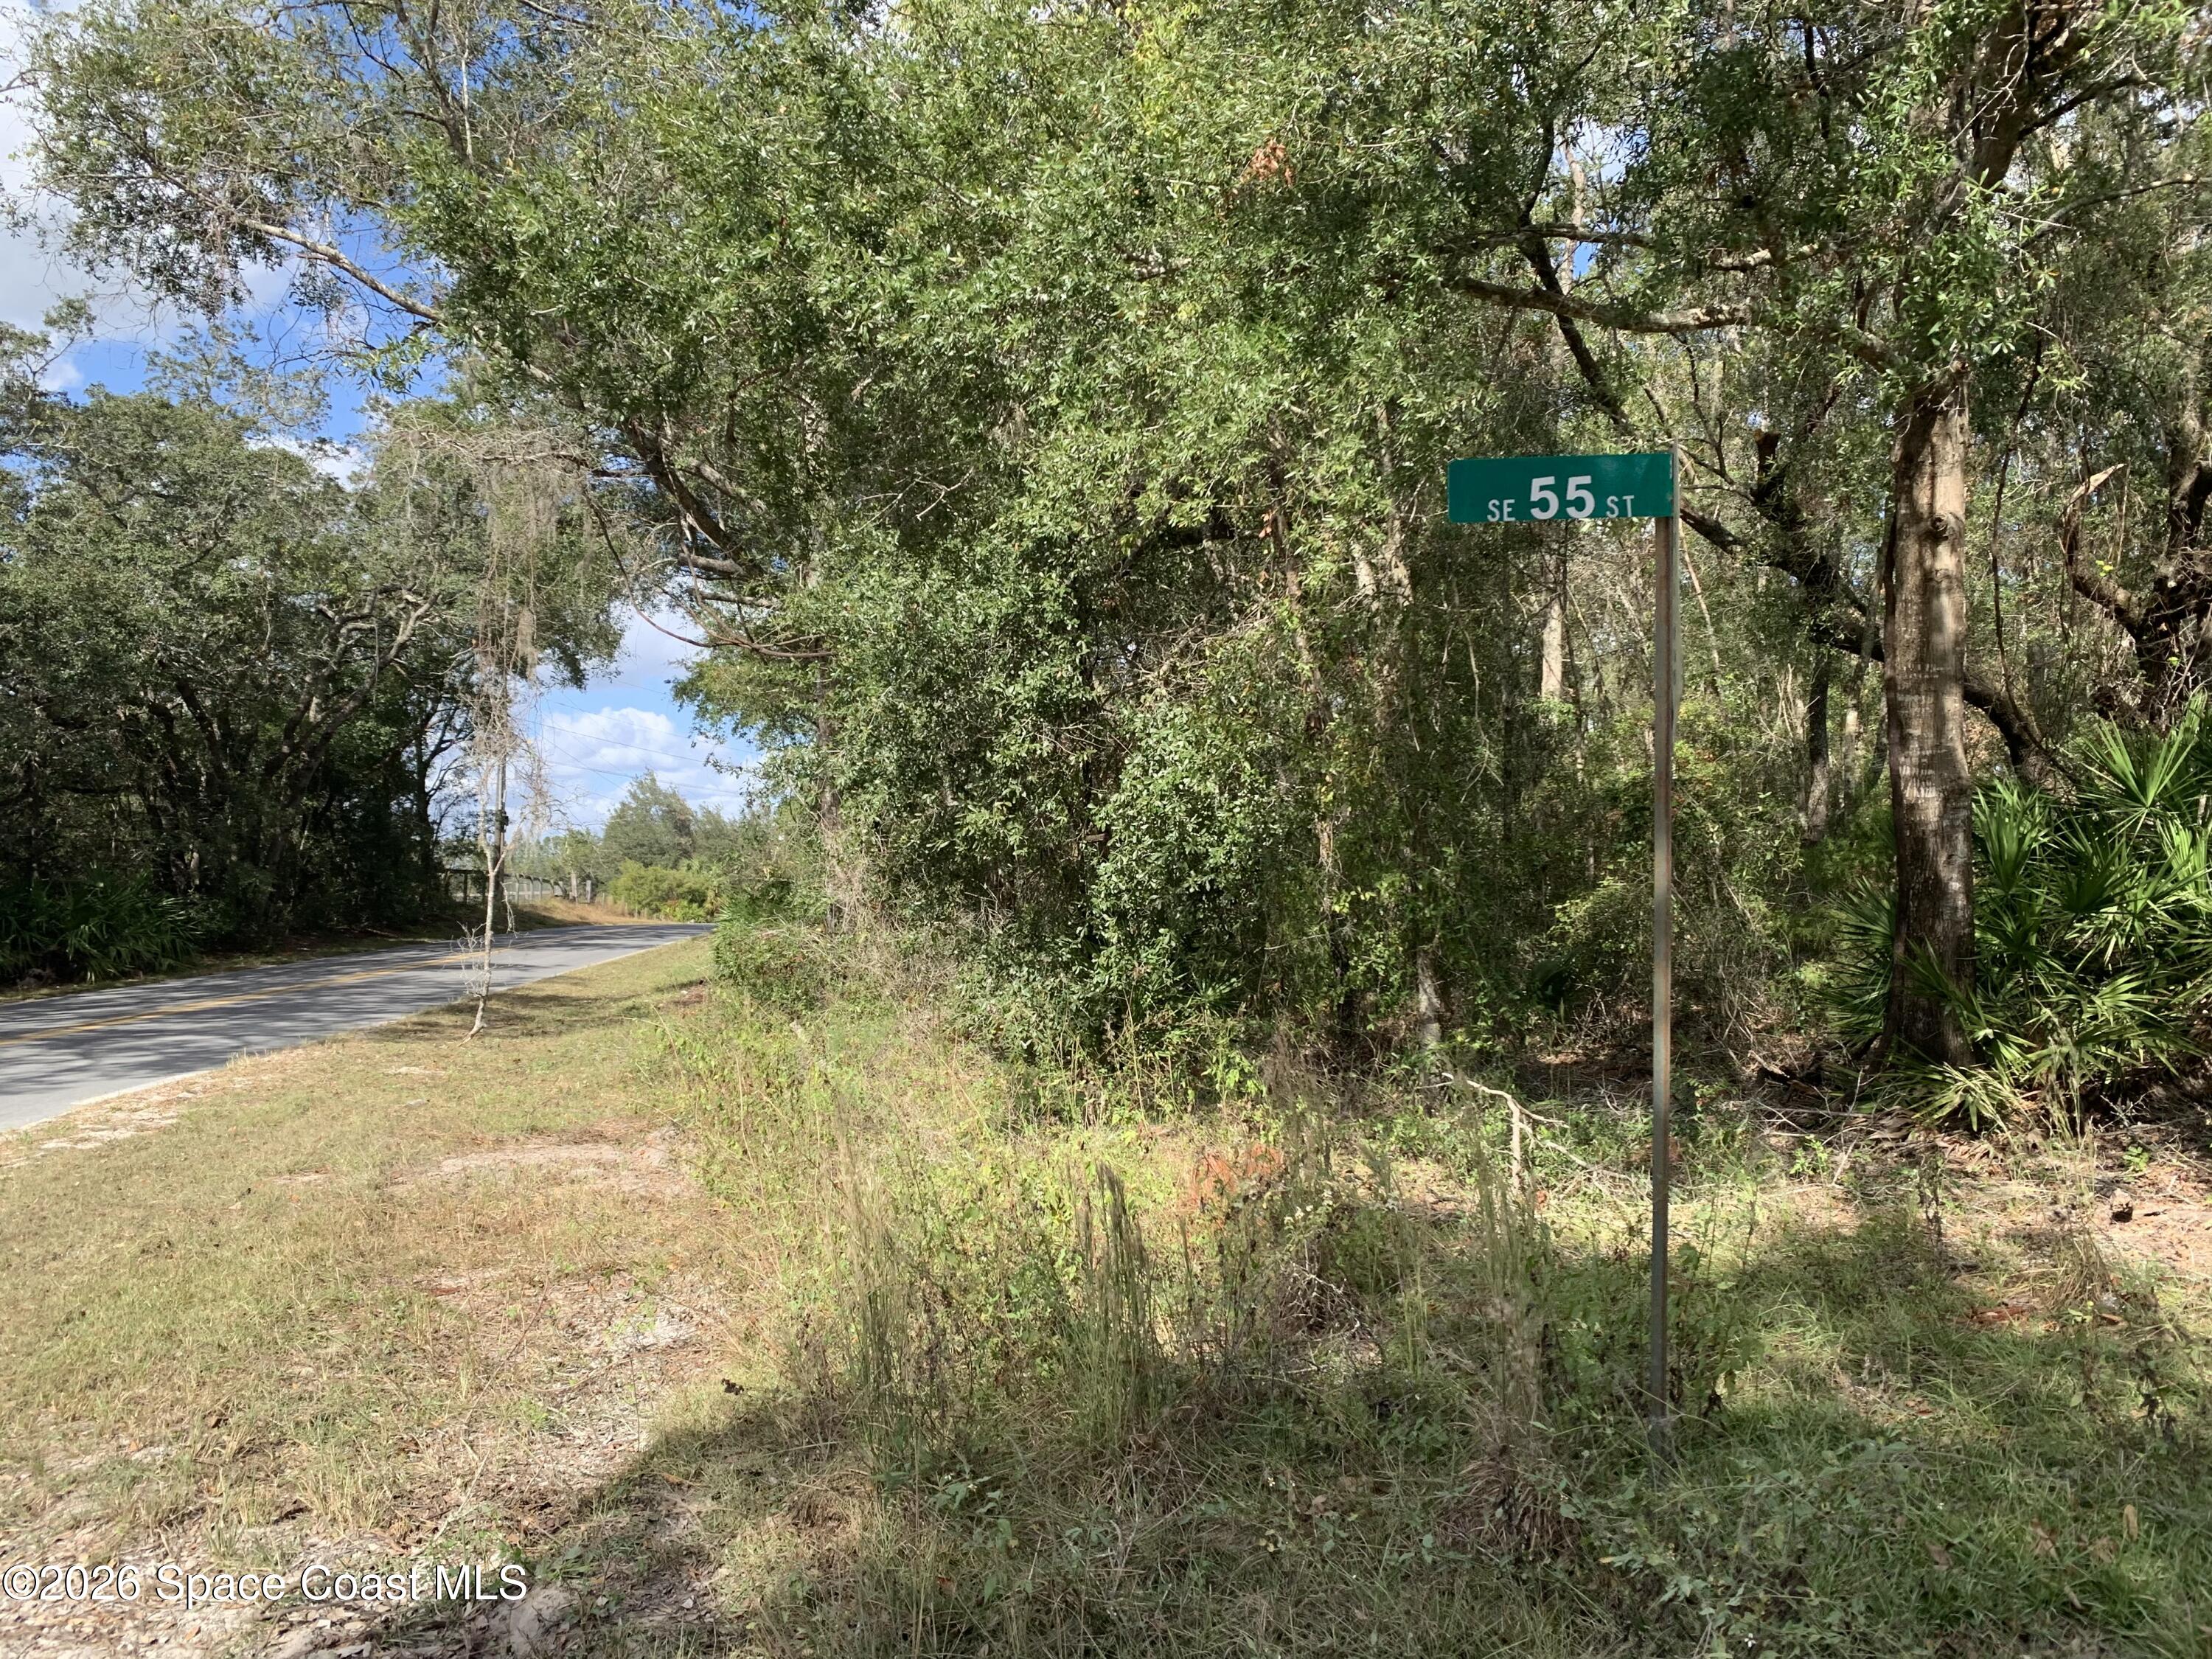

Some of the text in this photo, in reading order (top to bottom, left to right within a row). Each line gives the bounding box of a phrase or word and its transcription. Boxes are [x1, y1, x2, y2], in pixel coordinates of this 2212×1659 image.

[1486, 475, 1635, 522] SE 55 ST
